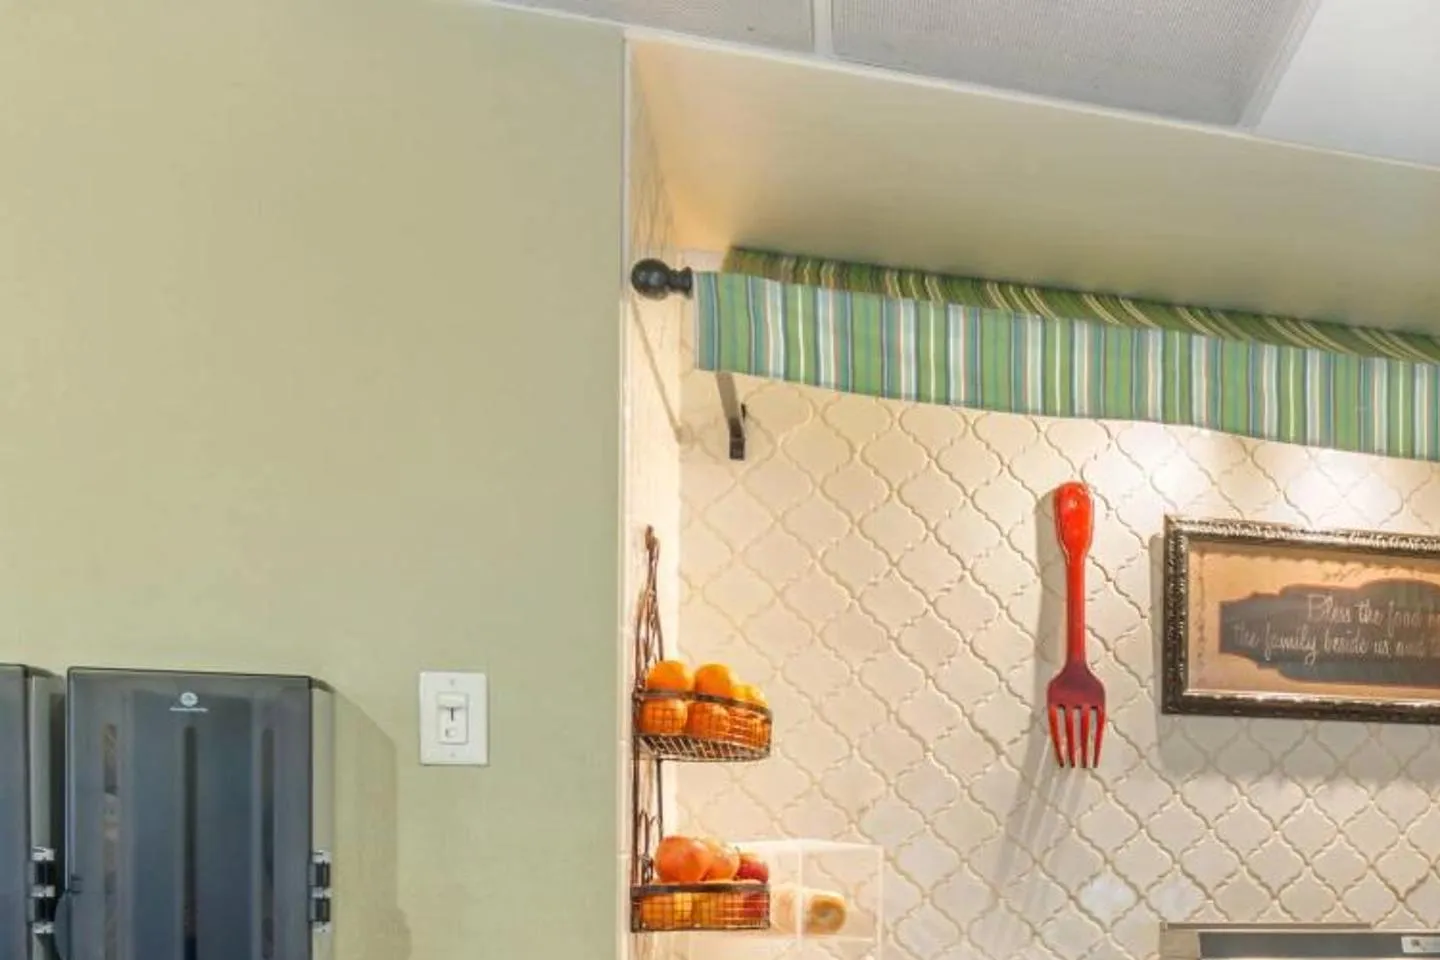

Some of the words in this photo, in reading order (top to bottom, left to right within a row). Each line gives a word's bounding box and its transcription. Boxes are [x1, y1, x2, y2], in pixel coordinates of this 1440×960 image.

[1307, 593, 1351, 623] Bless
[1354, 598, 1383, 625] the
[1387, 599, 1422, 637] food
[1264, 620, 1317, 666] family
[1324, 627, 1368, 655] beside
